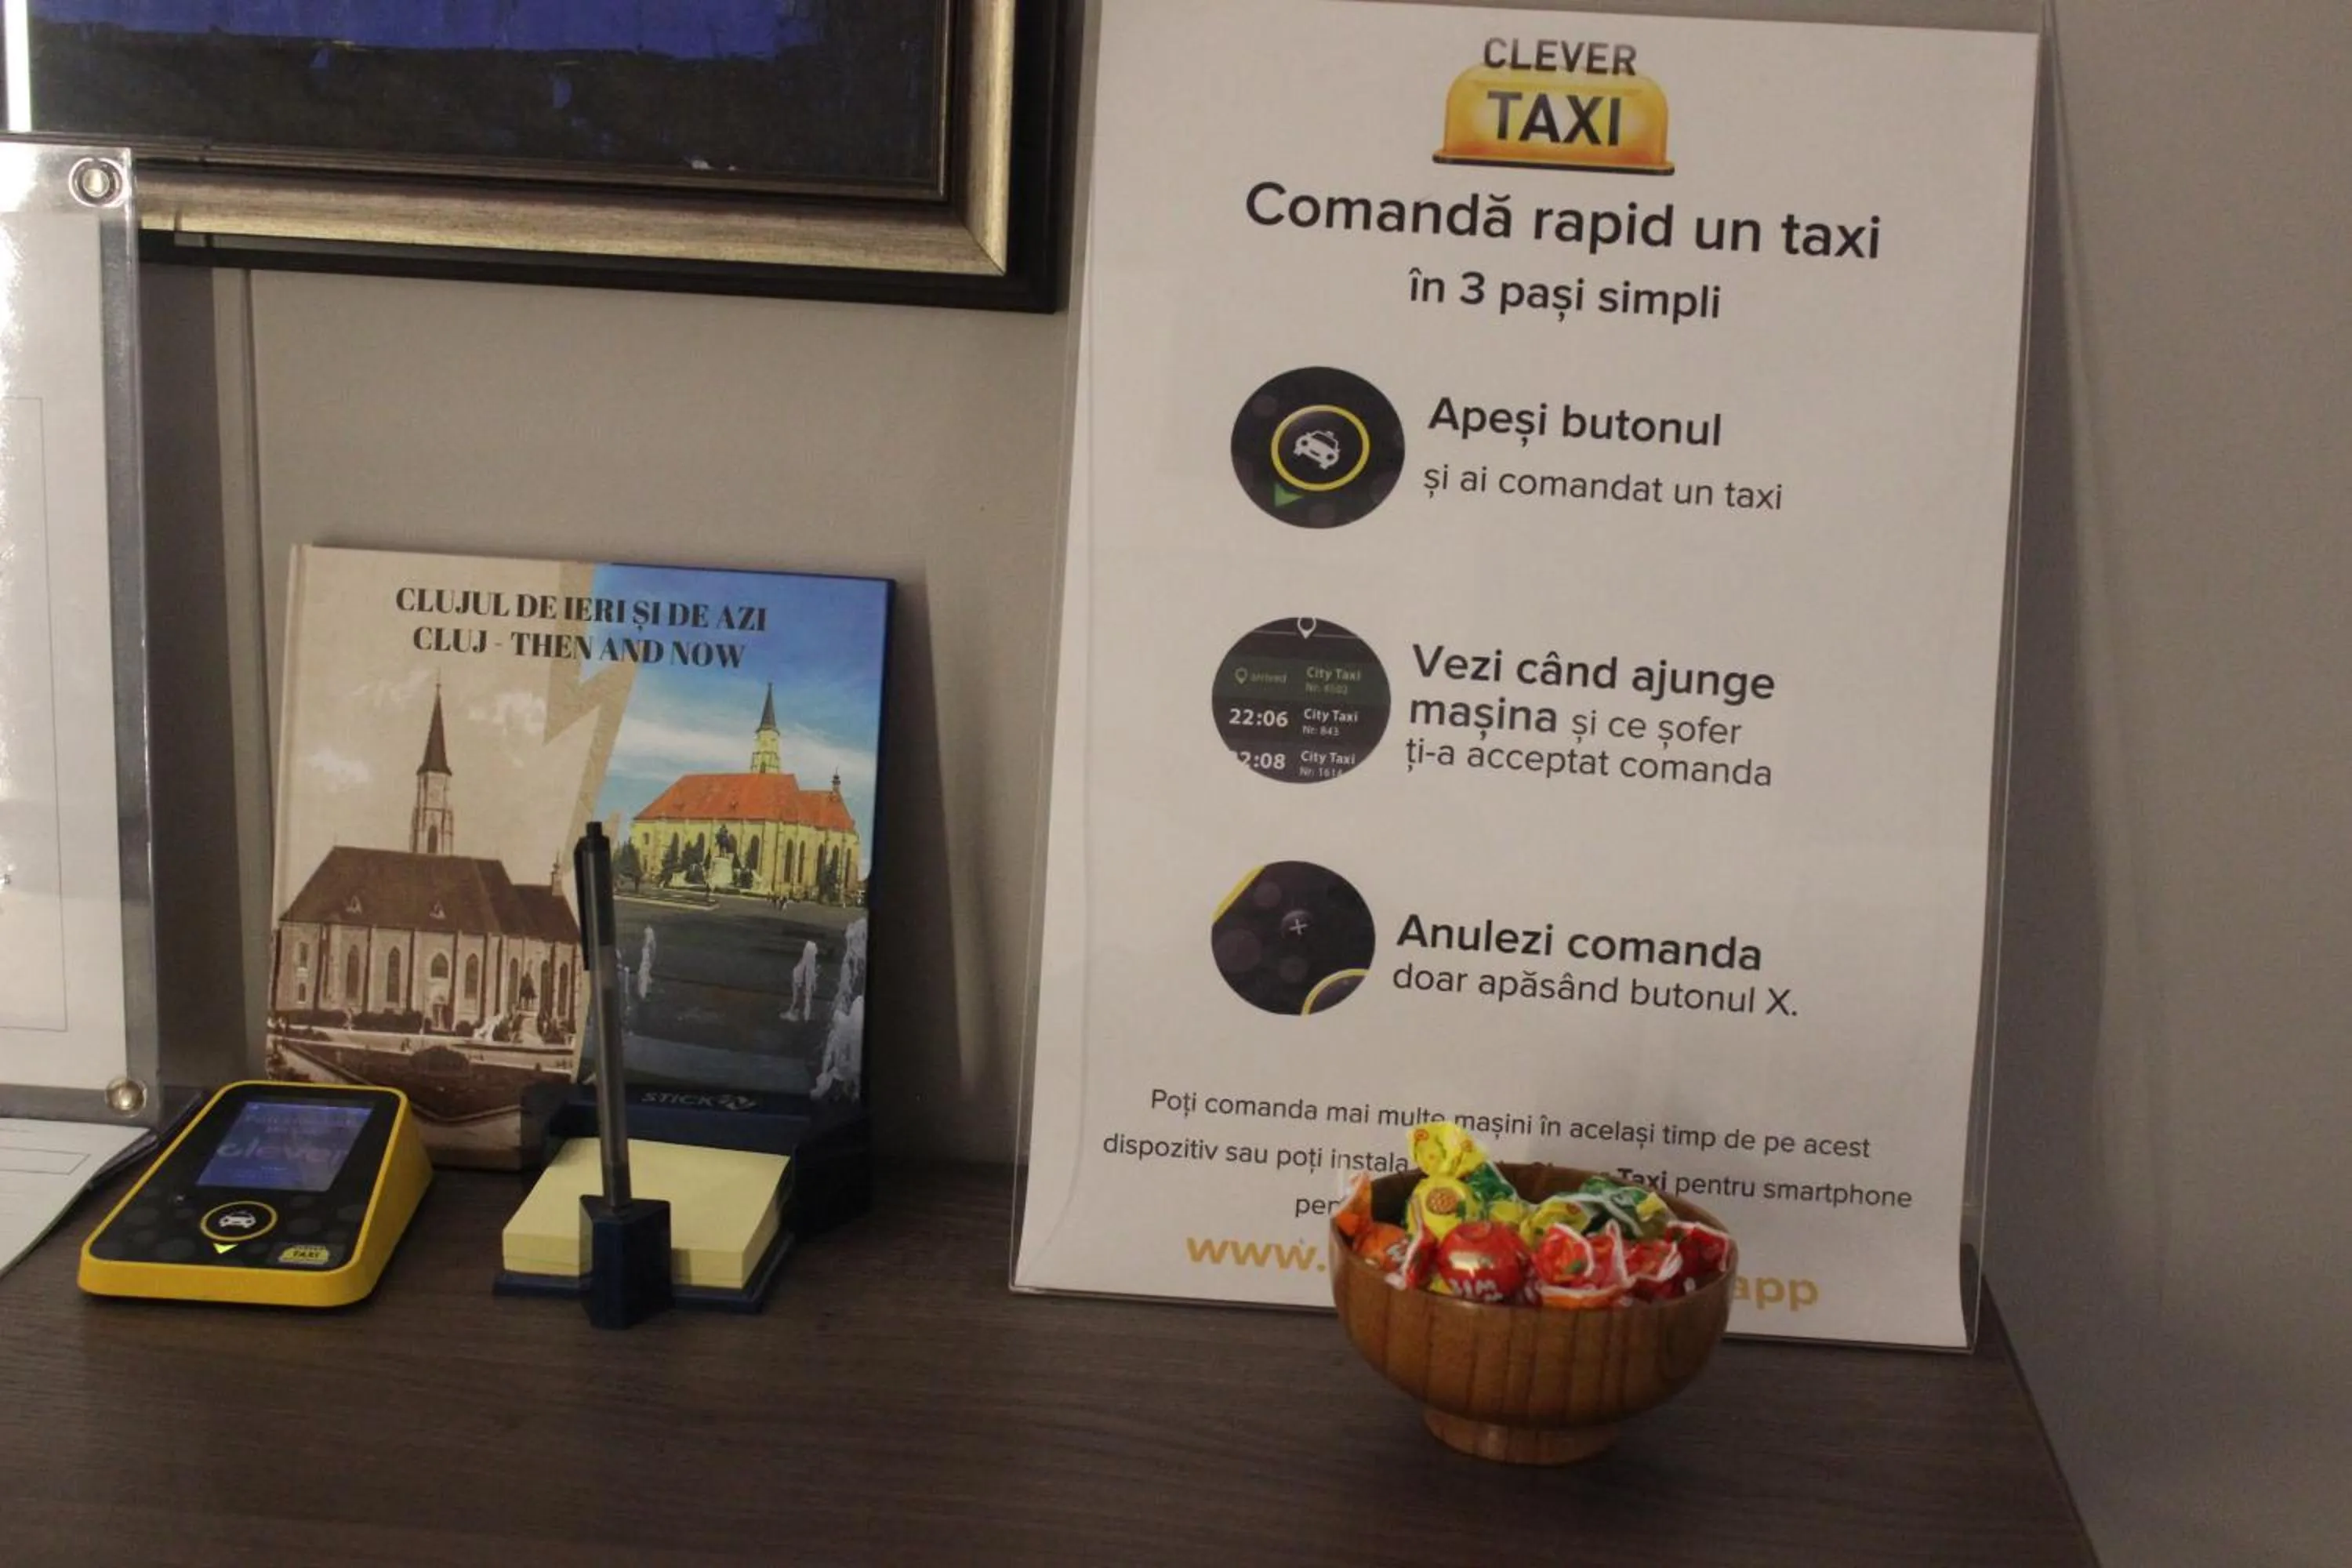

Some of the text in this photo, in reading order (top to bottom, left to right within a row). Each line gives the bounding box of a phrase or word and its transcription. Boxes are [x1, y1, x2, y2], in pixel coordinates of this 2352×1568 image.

[1483, 37, 1637, 76] CLEVER
[1487, 90, 1621, 147] TAXI
[1247, 182, 1880, 259] Comandă rapid un taxi
[1410, 267, 1720, 325] în 3 pași simpli
[1428, 397, 1720, 447] Apeși butonul
[1424, 464, 1781, 510] și ai comandat un taxi
[397, 588, 768, 632] CLUJUL DE IERI ȘI DE AZI
[414, 627, 486, 652] CLUJ
[511, 632, 593, 659] THEN
[600, 637, 663, 664] AND
[672, 641, 747, 669] NOW
[1306, 666, 1361, 681] City Taxi
[1413, 644, 1774, 706] Vezi când ajunge
[1229, 708, 1288, 728] 22:06
[1304, 709, 1359, 723] City Taxi
[1410, 697, 1741, 750] mașina și ce șofer
[1301, 750, 1356, 765] City Taxi
[1406, 739, 1770, 786] ți-a acceptat comanda
[1397, 914, 1761, 970] Anulezi comanda
[1393, 963, 1797, 1016] doar apăsând butonul X.
[1152, 1089, 1869, 1157] Poți comanda mai multe mașini în același timp de pe acest
[1104, 1133, 1218, 1160] dispozitiv
[1226, 1146, 1268, 1163] sau
[1277, 1148, 1322, 1174] poți
[1331, 1149, 1408, 1173] instala
[1675, 1177, 1755, 1197] pentru
[1764, 1183, 1912, 1207] smartphone
